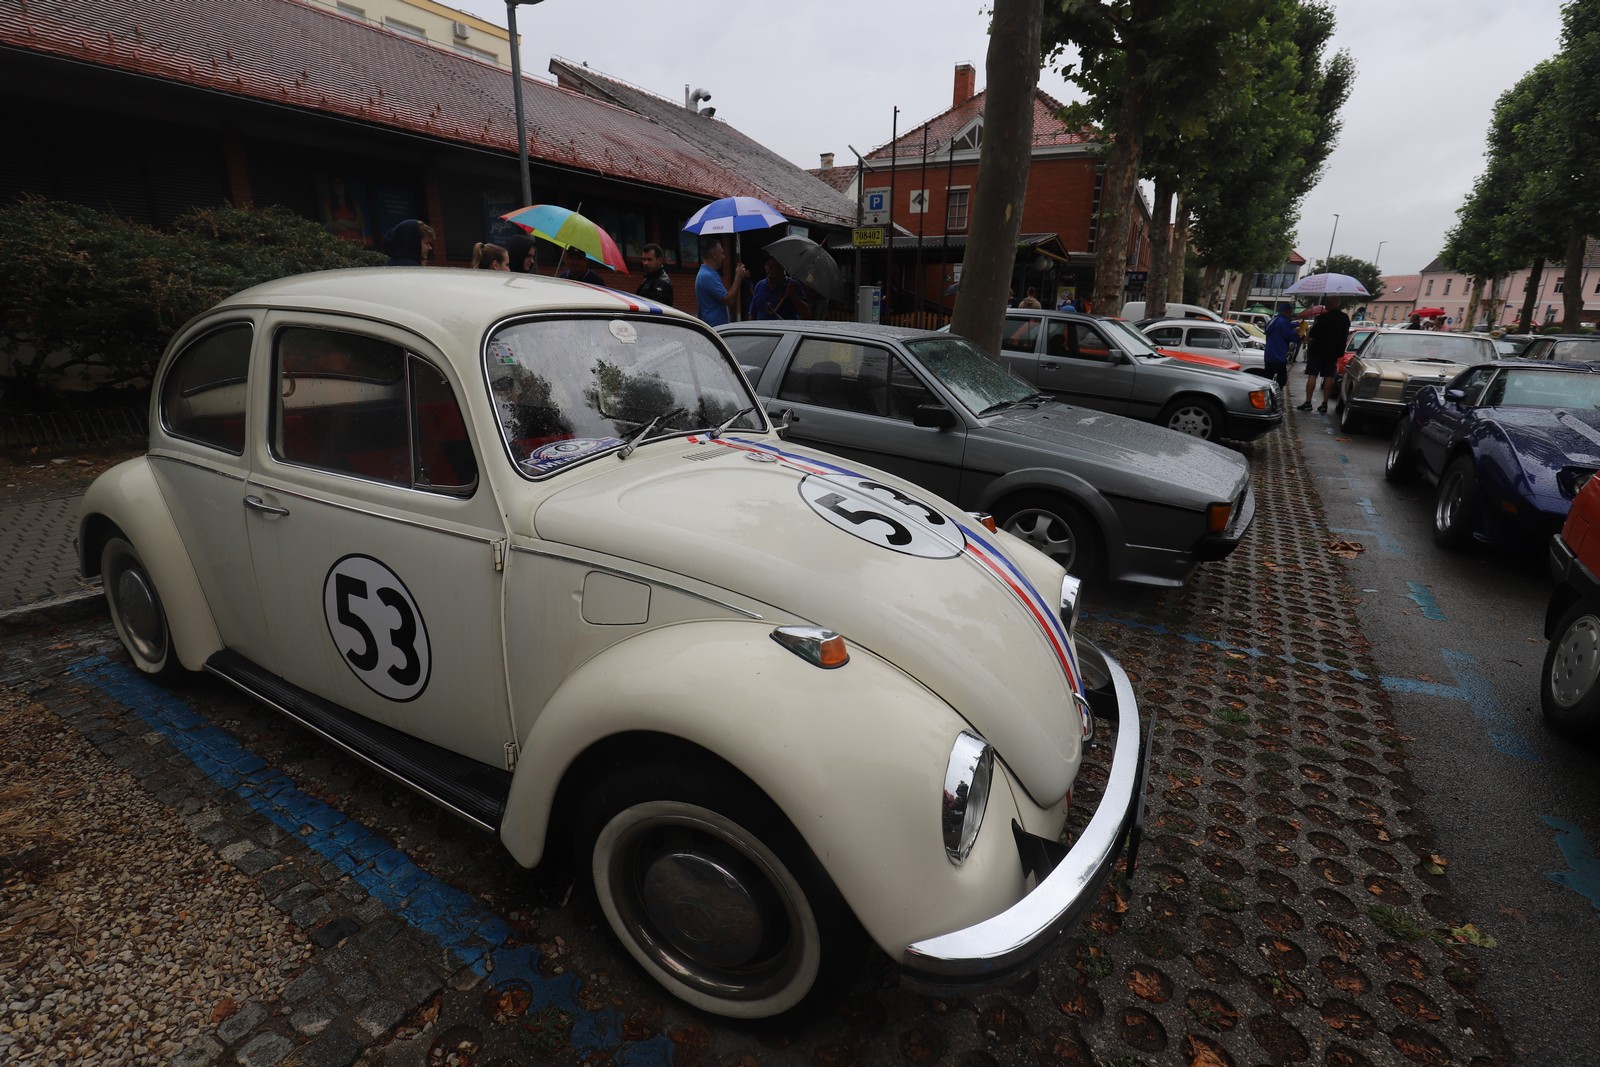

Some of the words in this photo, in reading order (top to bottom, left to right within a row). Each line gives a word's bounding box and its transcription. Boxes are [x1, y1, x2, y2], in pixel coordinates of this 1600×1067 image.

[873, 197, 880, 207] P
[855, 230, 880, 241] 708402
[814, 481, 946, 546] 53
[336, 572, 421, 687] 53
